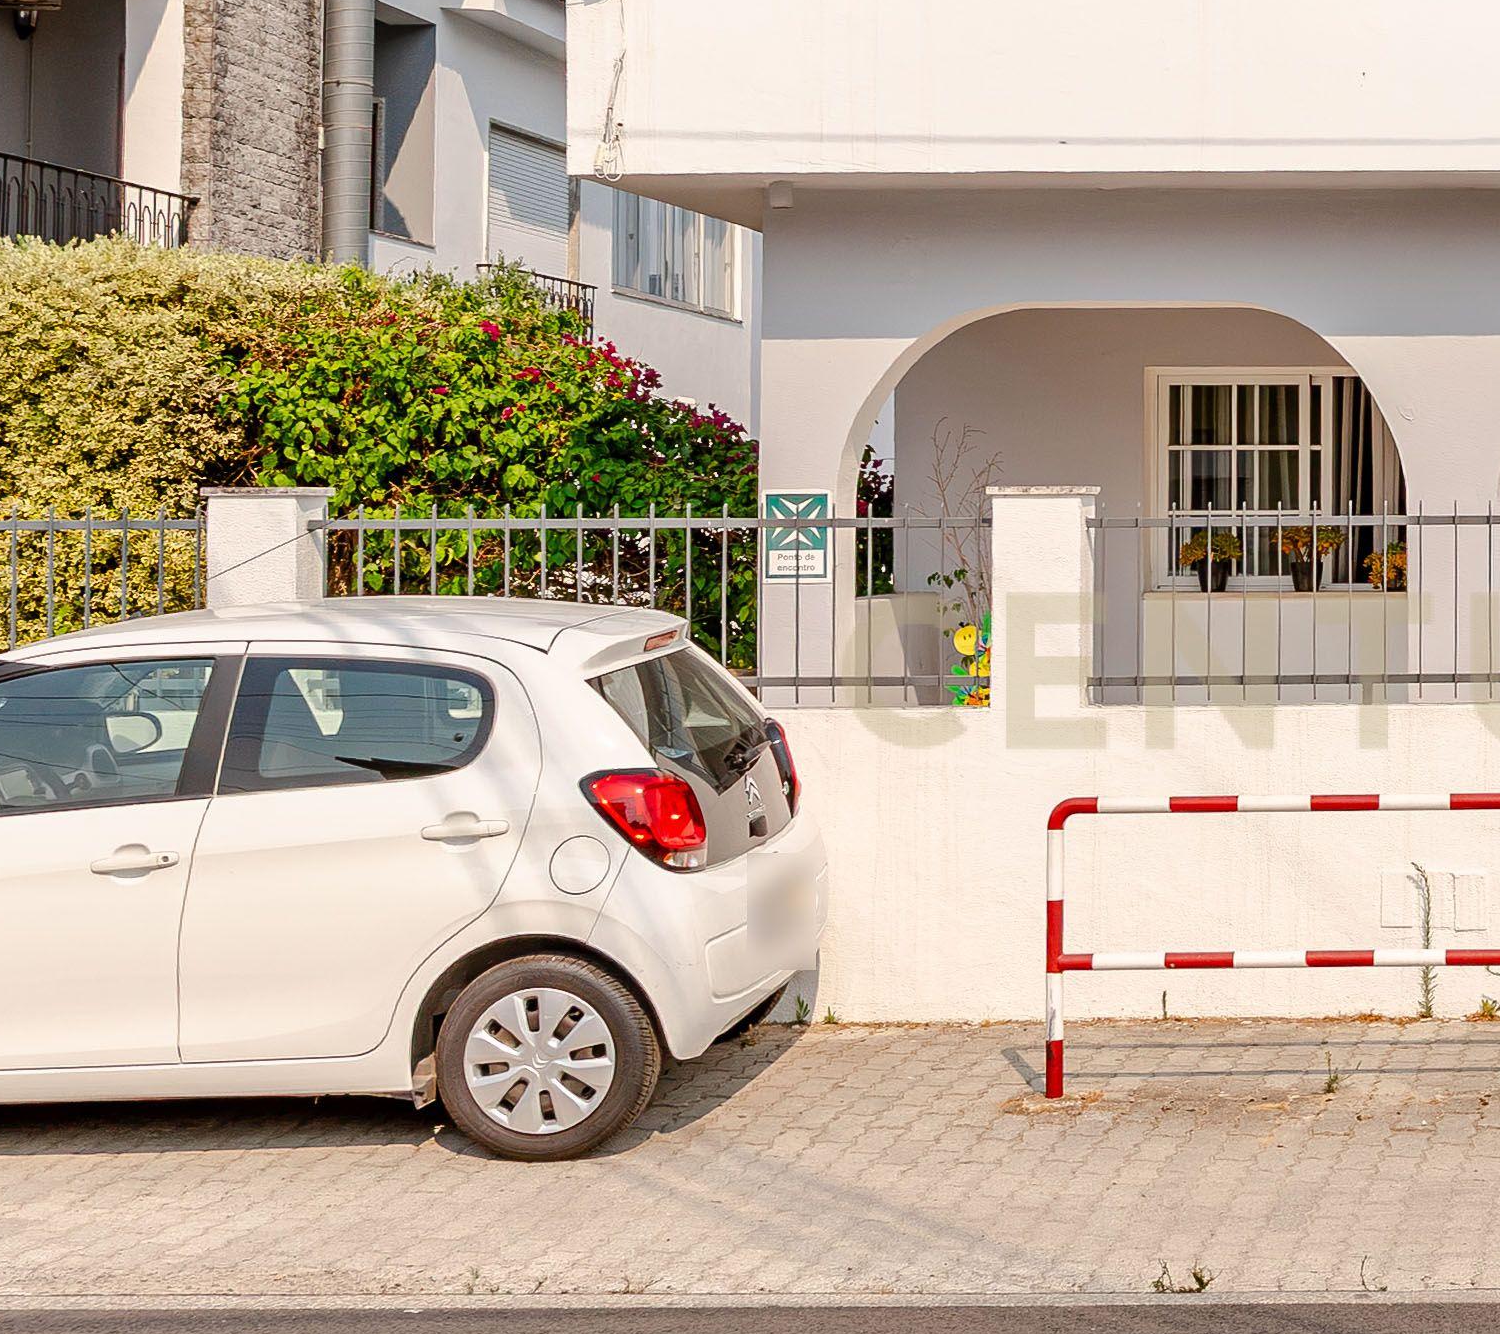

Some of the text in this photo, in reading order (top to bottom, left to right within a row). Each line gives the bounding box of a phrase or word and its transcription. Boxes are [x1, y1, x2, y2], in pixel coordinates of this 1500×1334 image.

[777, 553, 816, 561] Ponto de
[777, 563, 816, 572] encontro
